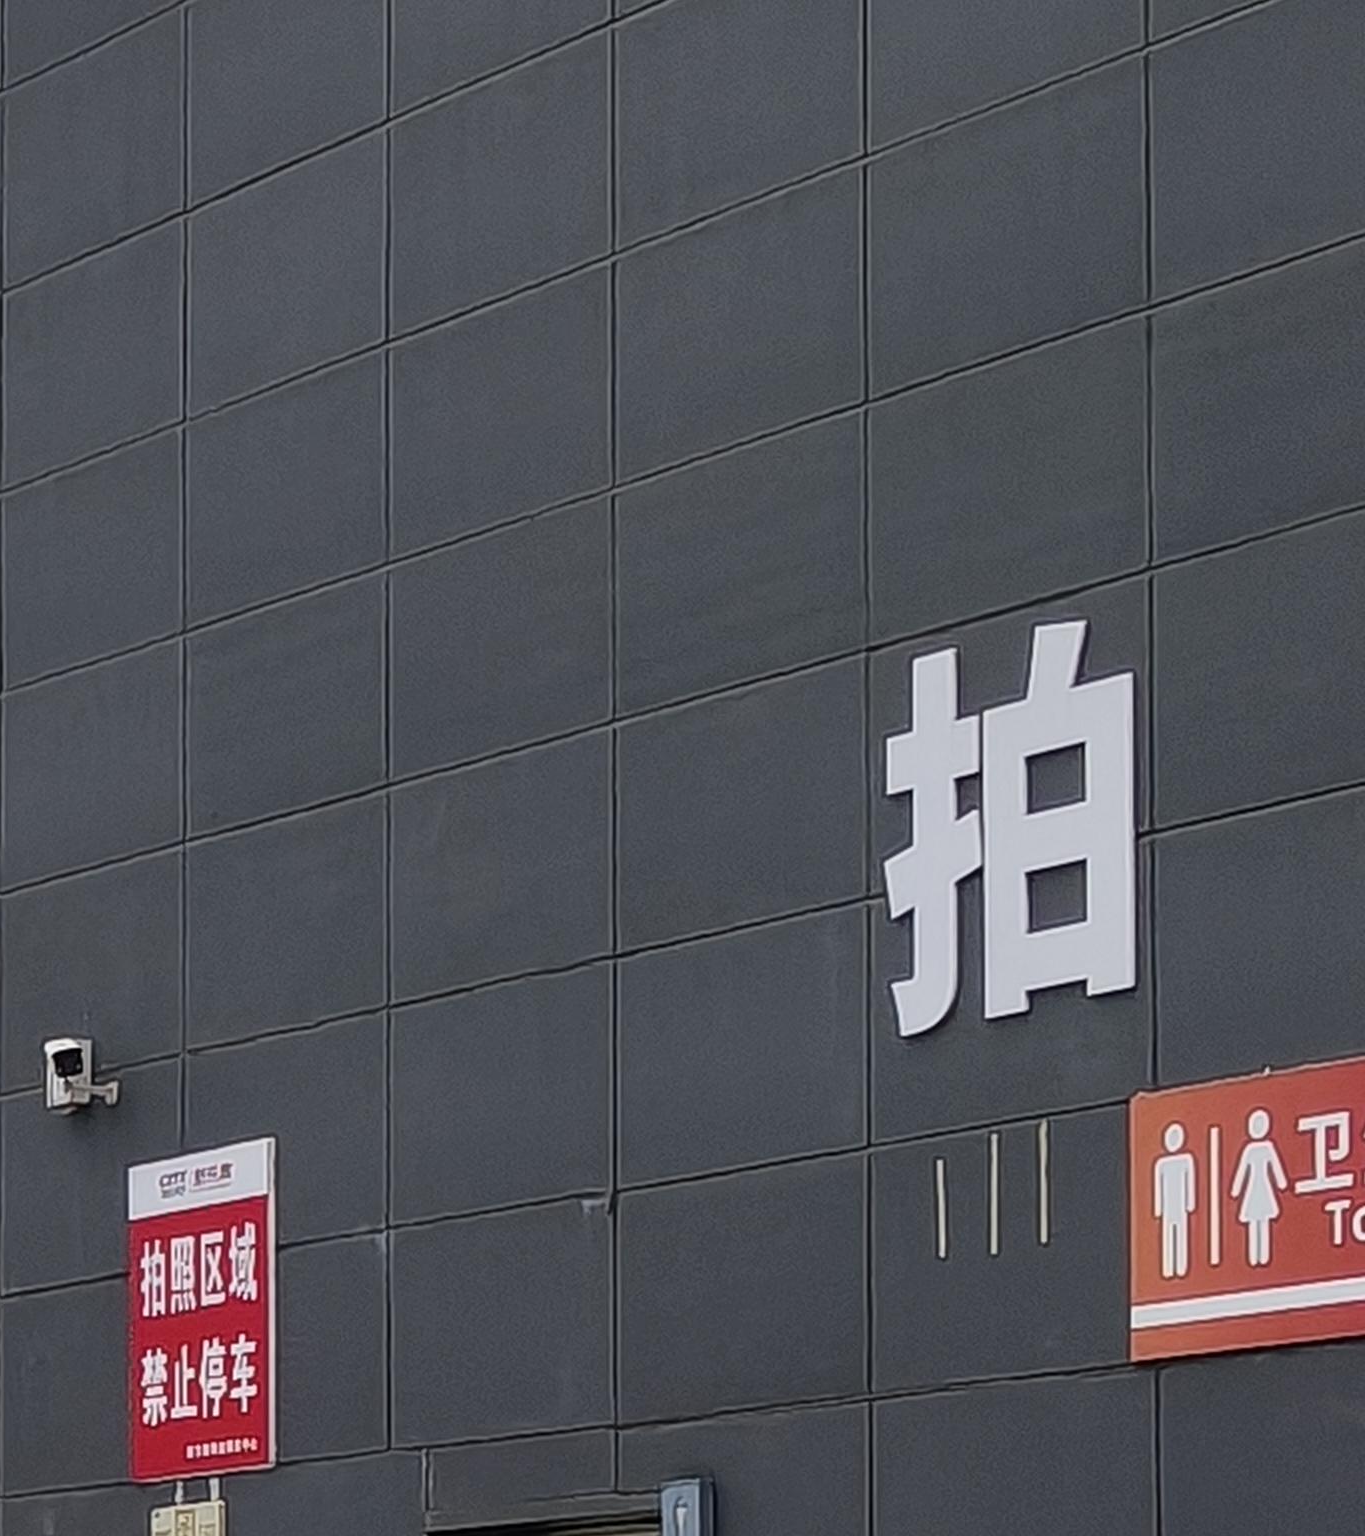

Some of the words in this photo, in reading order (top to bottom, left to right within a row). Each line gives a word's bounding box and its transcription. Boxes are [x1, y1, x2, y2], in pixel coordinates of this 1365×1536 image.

[883, 619, 1136, 1038] 拍
[1294, 1110, 1365, 1194] 卫
[140, 1221, 257, 1317] 拍照区域
[140, 1333, 258, 1427] 禁止停车
